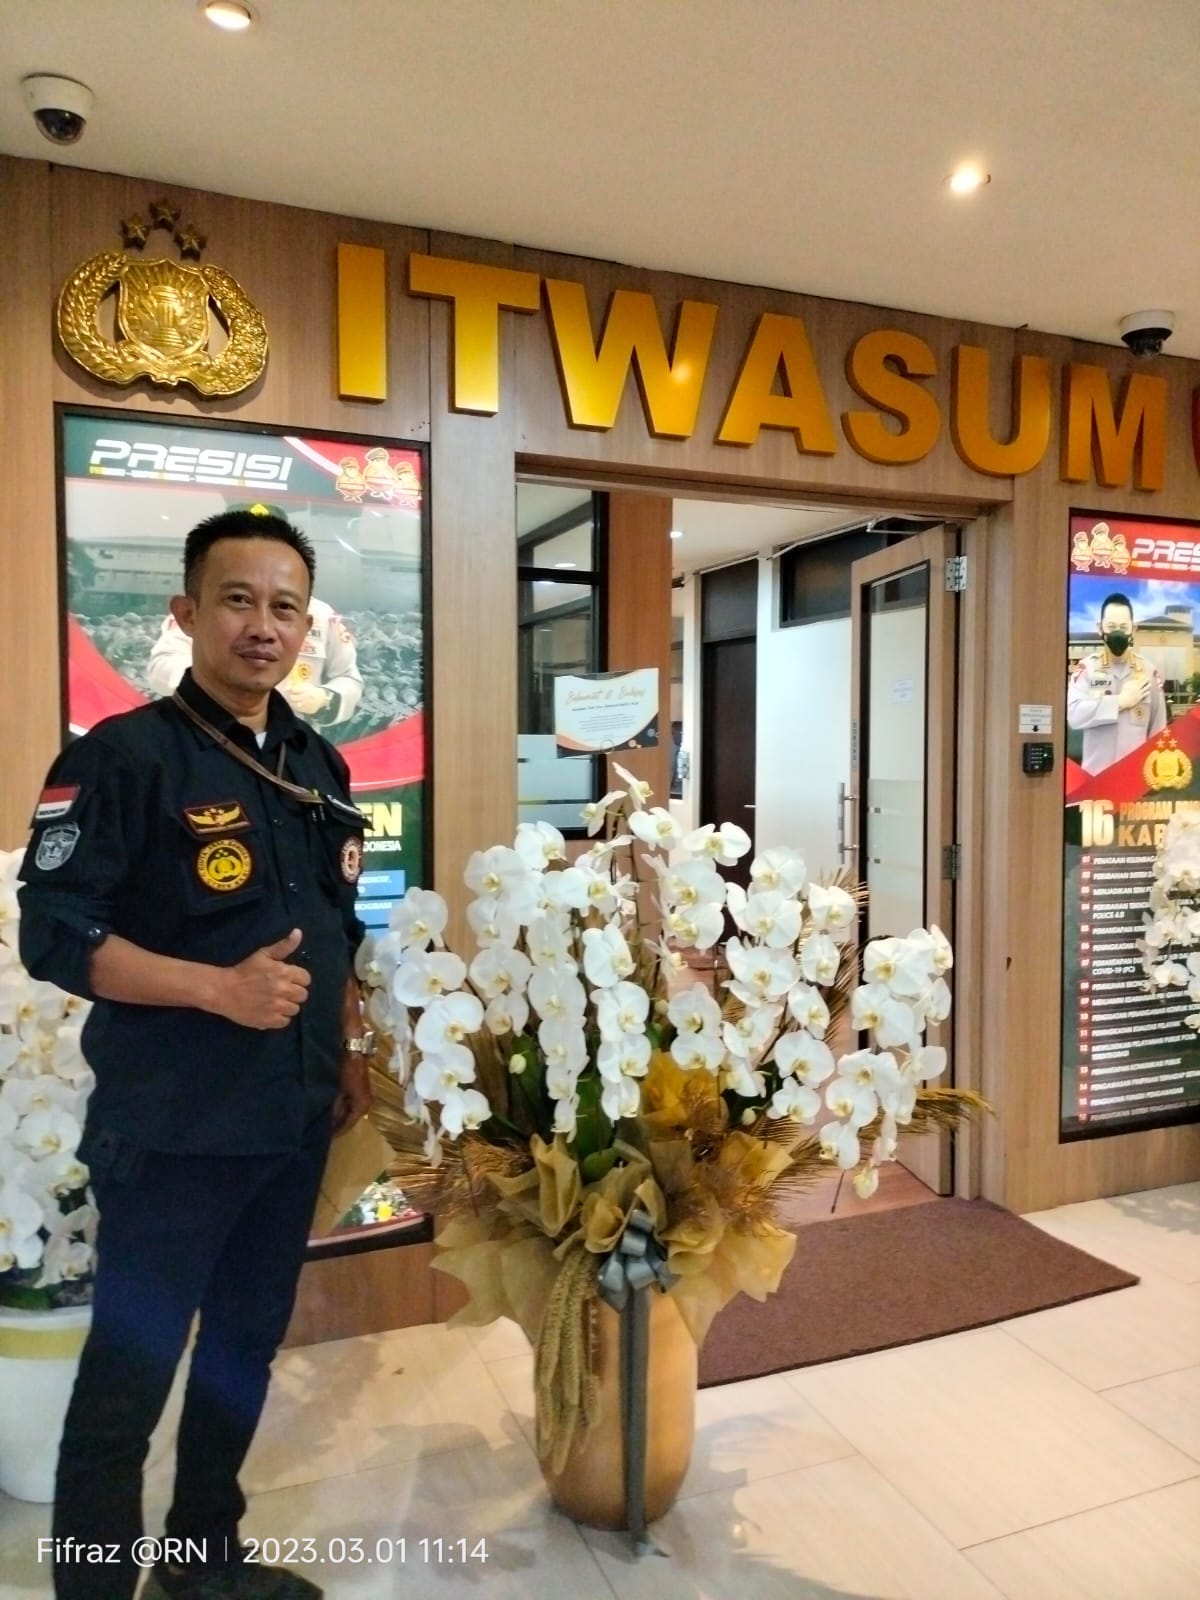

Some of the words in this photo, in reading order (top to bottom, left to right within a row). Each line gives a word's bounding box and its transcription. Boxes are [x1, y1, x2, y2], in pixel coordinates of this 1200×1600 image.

[337, 243, 1168, 493] ITWASUM
[90, 439, 293, 481] PRESISI
[1079, 799, 1115, 847] 16
